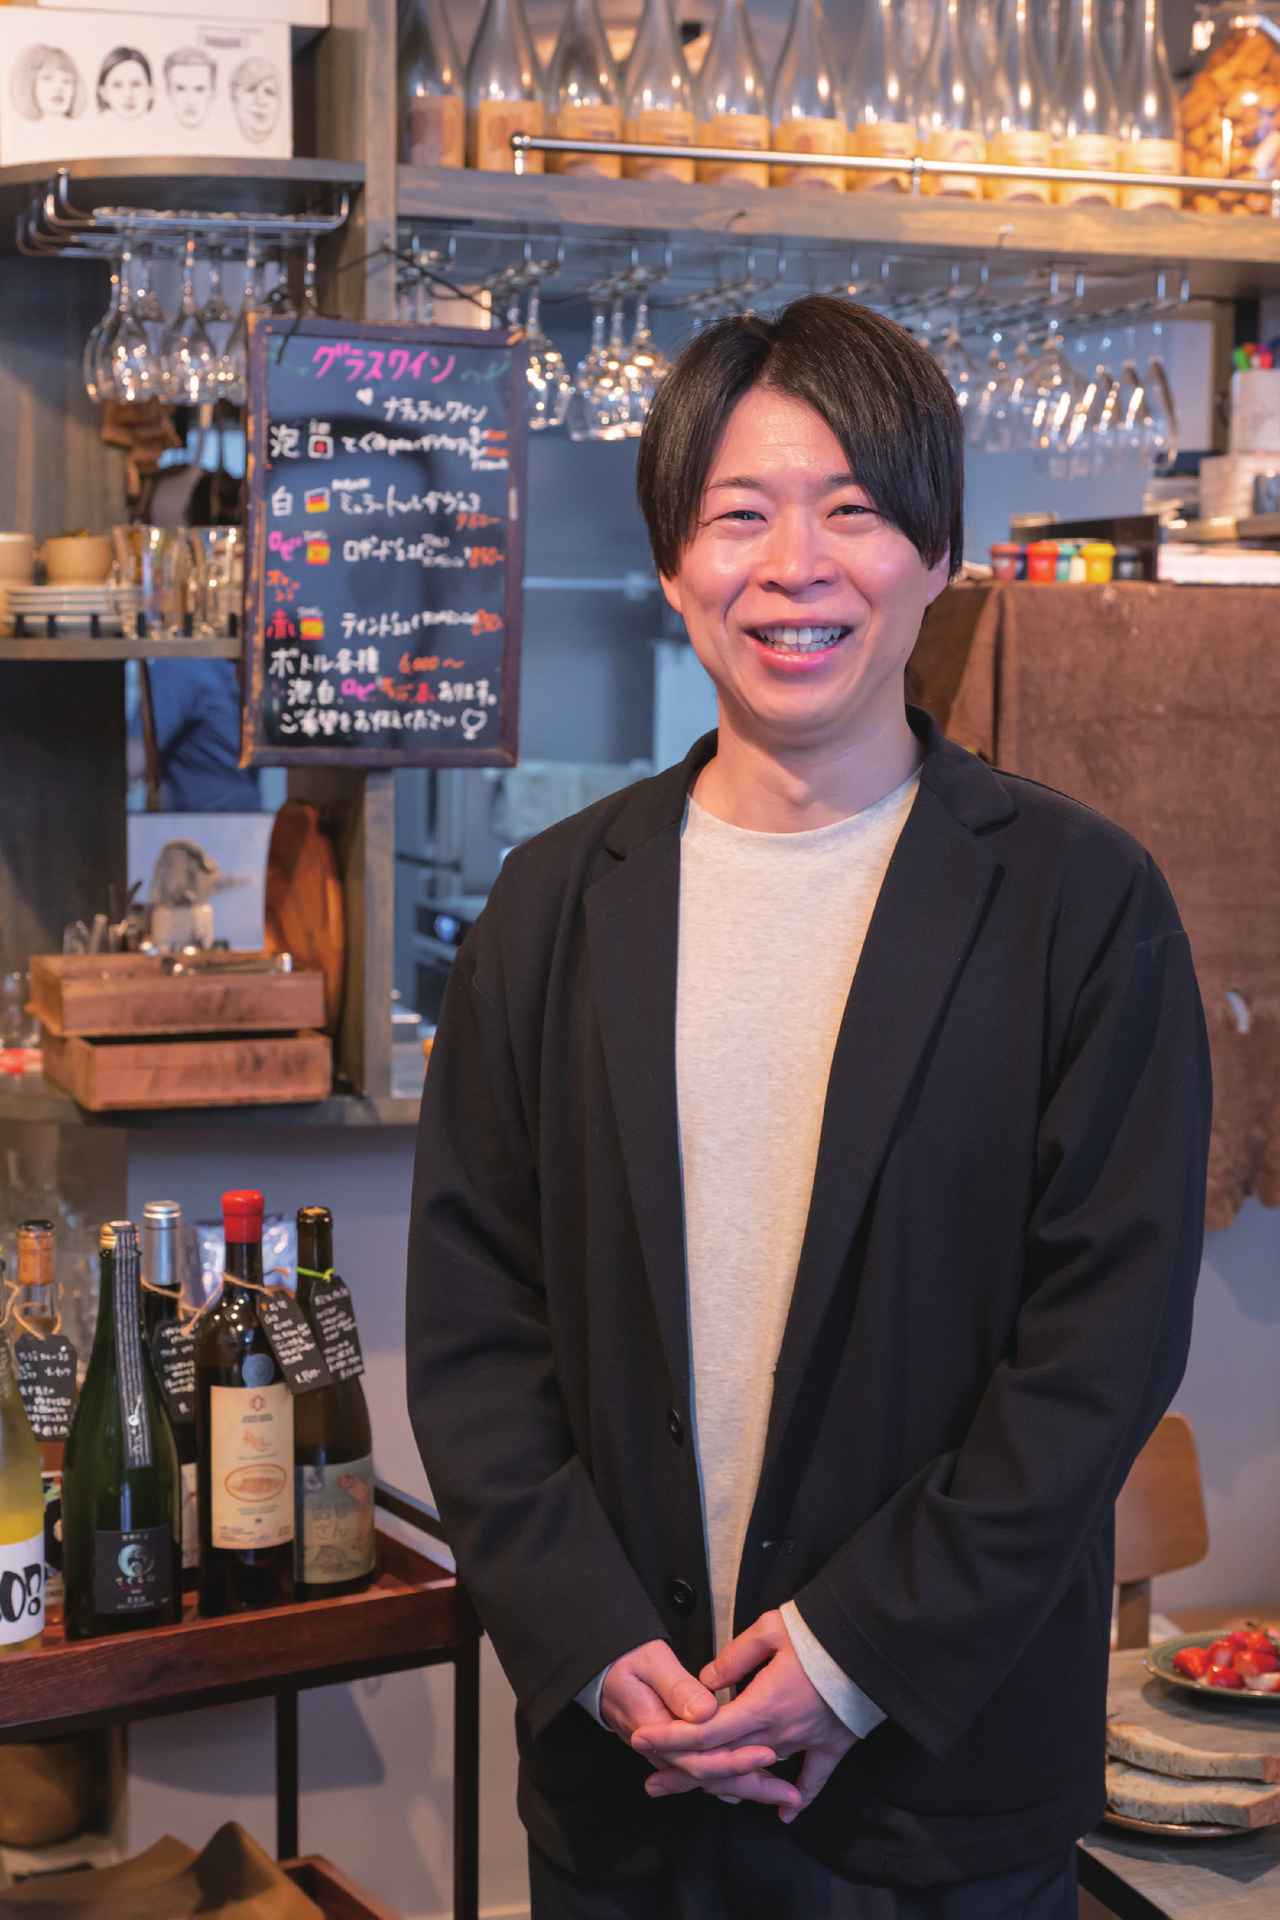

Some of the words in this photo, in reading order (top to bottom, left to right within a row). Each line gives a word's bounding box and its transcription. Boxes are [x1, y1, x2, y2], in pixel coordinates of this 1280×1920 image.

[312, 342, 456, 384] グラスワイン
[269, 423, 300, 459] 泡
[271, 485, 293, 516] 白
[268, 530, 303, 562] ロゼ
[266, 607, 296, 640] 赤
[268, 646, 379, 678] ボトル各種
